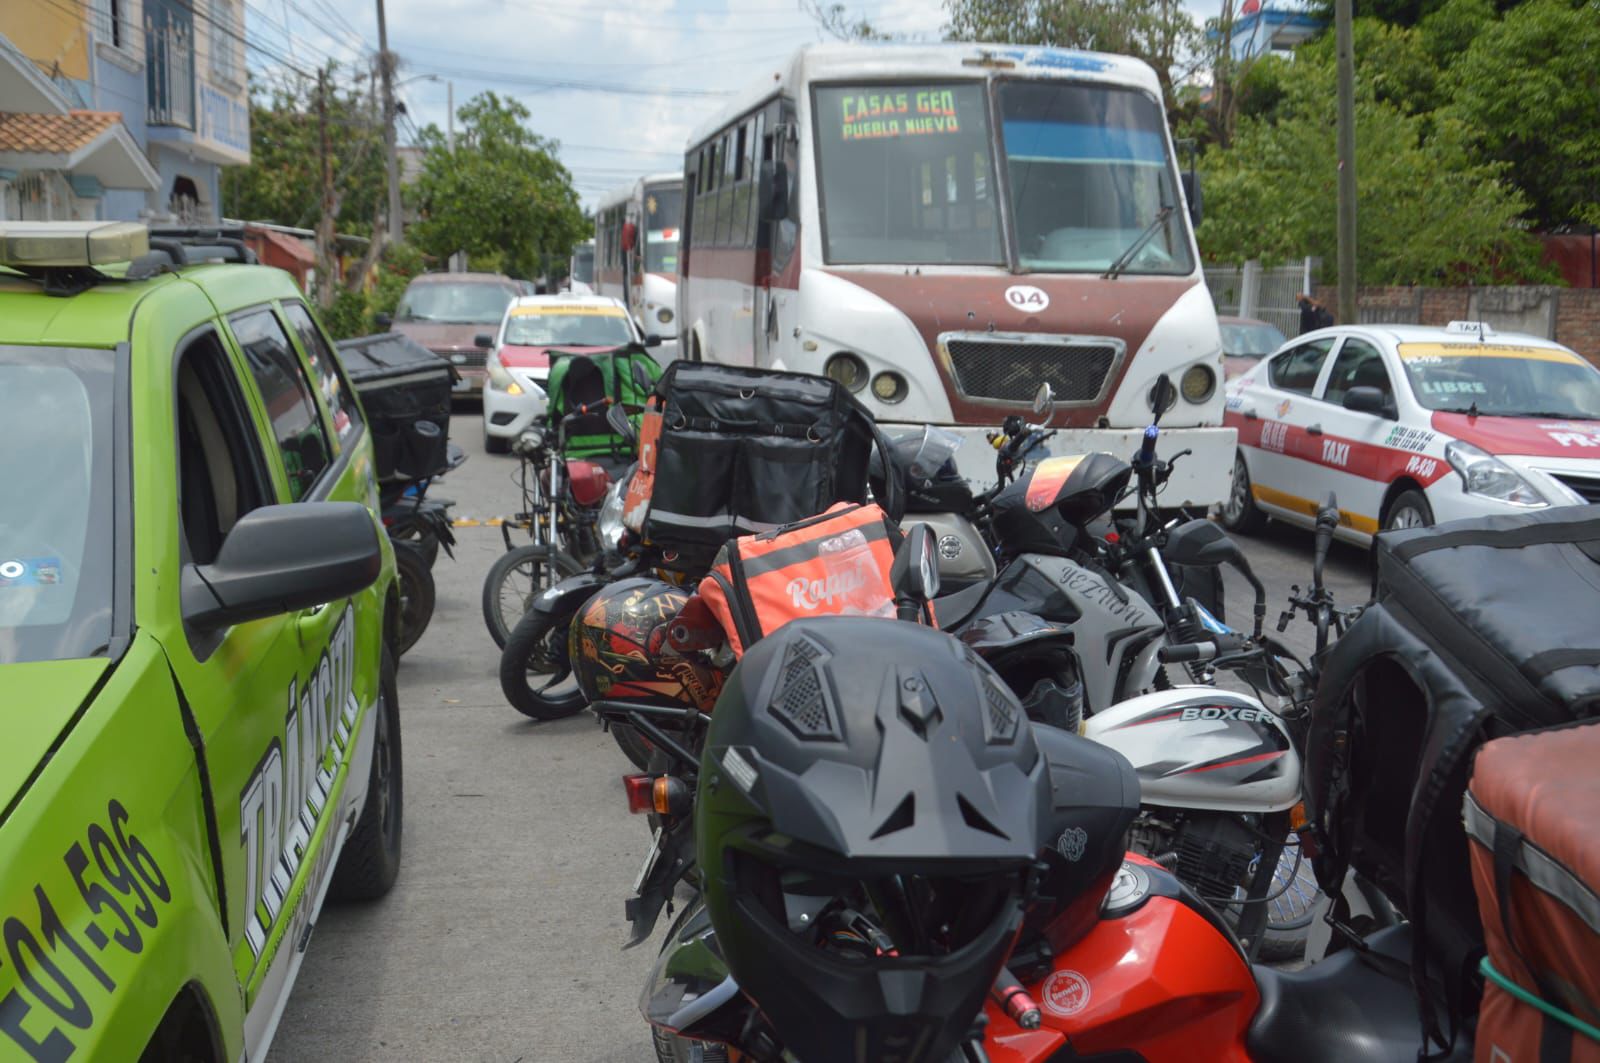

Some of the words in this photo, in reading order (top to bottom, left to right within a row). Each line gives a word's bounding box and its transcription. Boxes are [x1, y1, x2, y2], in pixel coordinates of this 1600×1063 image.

[842, 94, 908, 123] CASAS
[917, 90, 956, 116] GEO
[842, 120, 899, 141] PUEBLO
[905, 115, 960, 135] NUEVO
[1010, 290, 1044, 306] 04
[1421, 381, 1487, 394] LIBRE
[1322, 438, 1351, 467] TAXI
[785, 559, 865, 610] Rappi
[1179, 707, 1275, 725] BOXER
